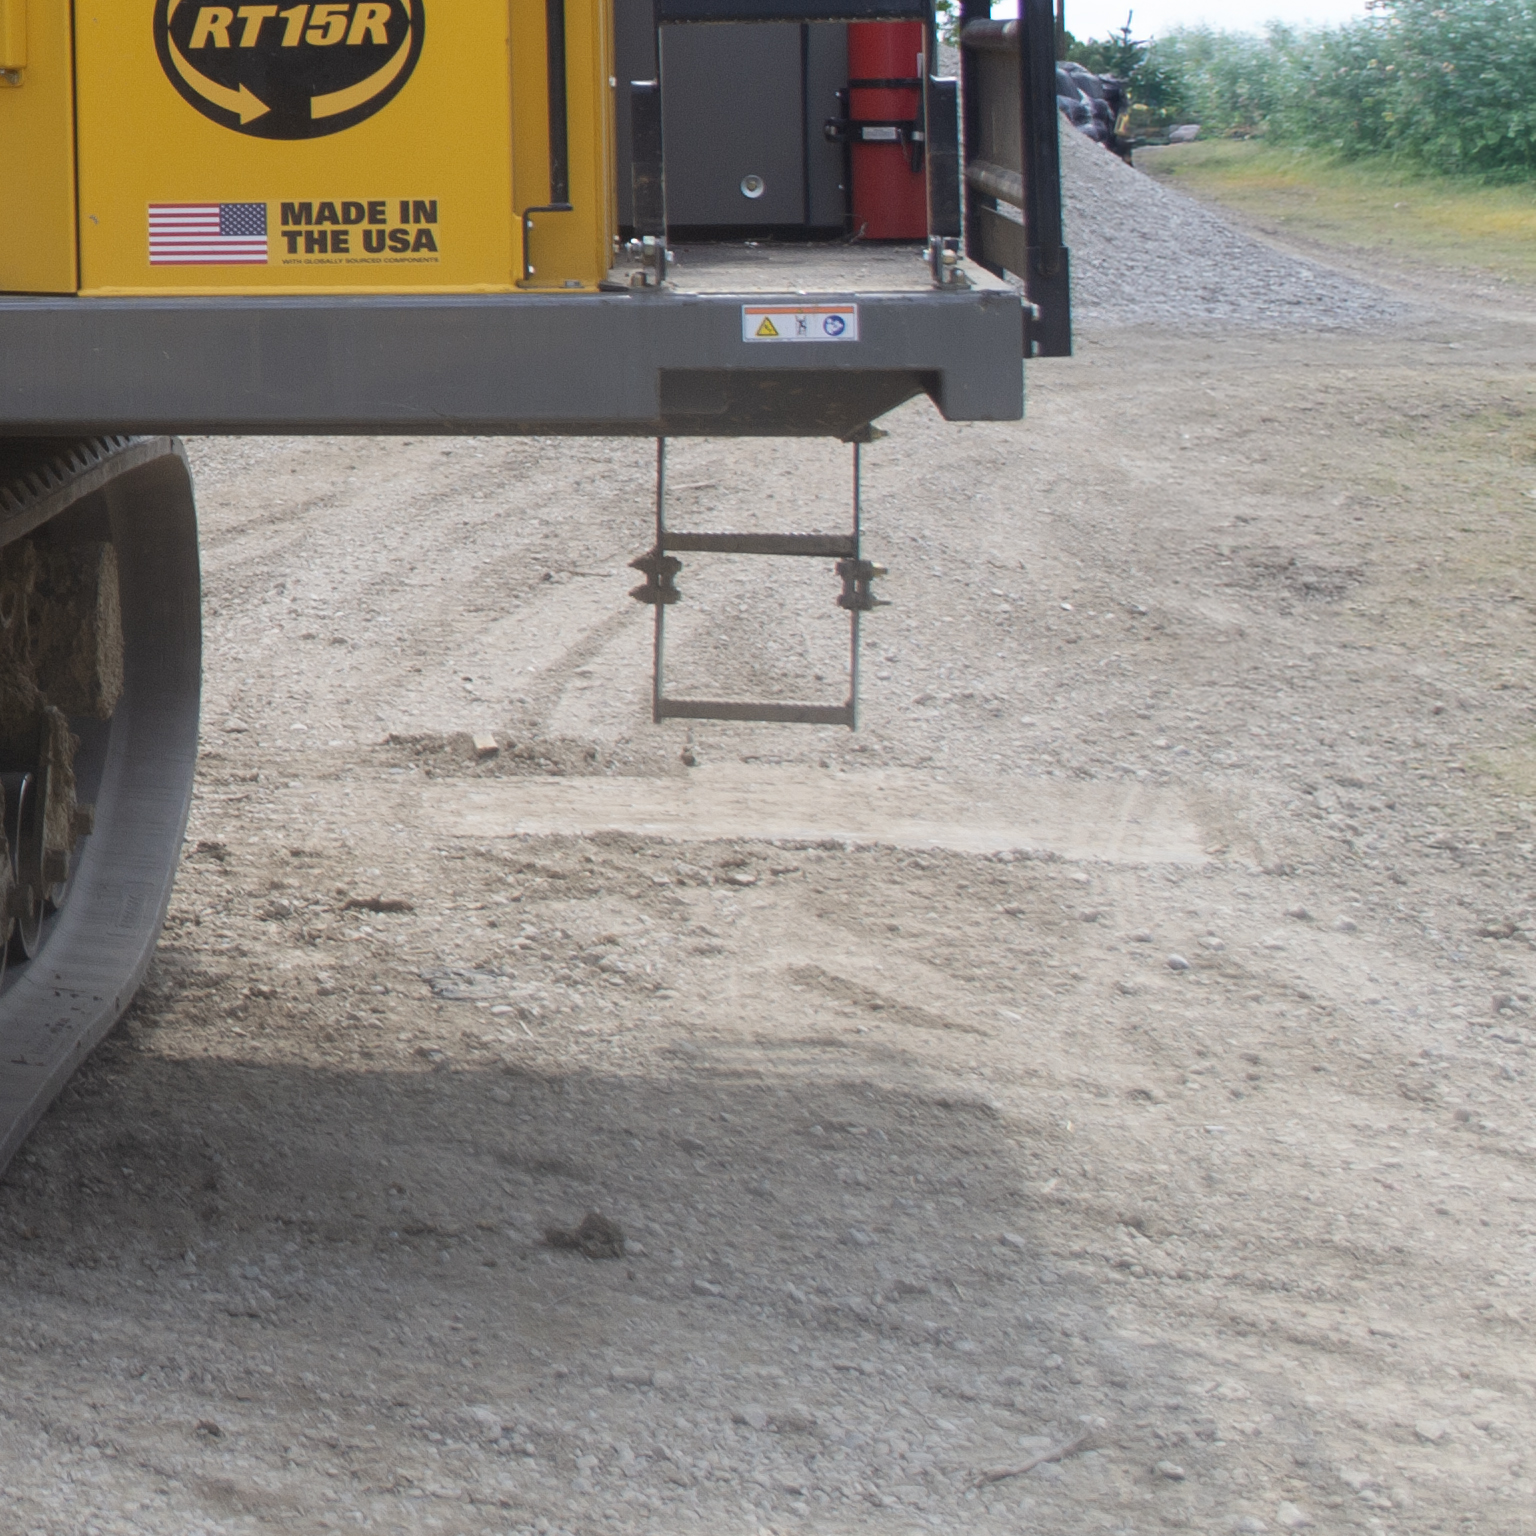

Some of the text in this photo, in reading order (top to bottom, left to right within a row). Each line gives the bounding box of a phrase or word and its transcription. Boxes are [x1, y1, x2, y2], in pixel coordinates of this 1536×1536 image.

[188, 2, 392, 49] RT15R
[280, 199, 438, 226] MADE IN
[280, 227, 439, 254] THE USA
